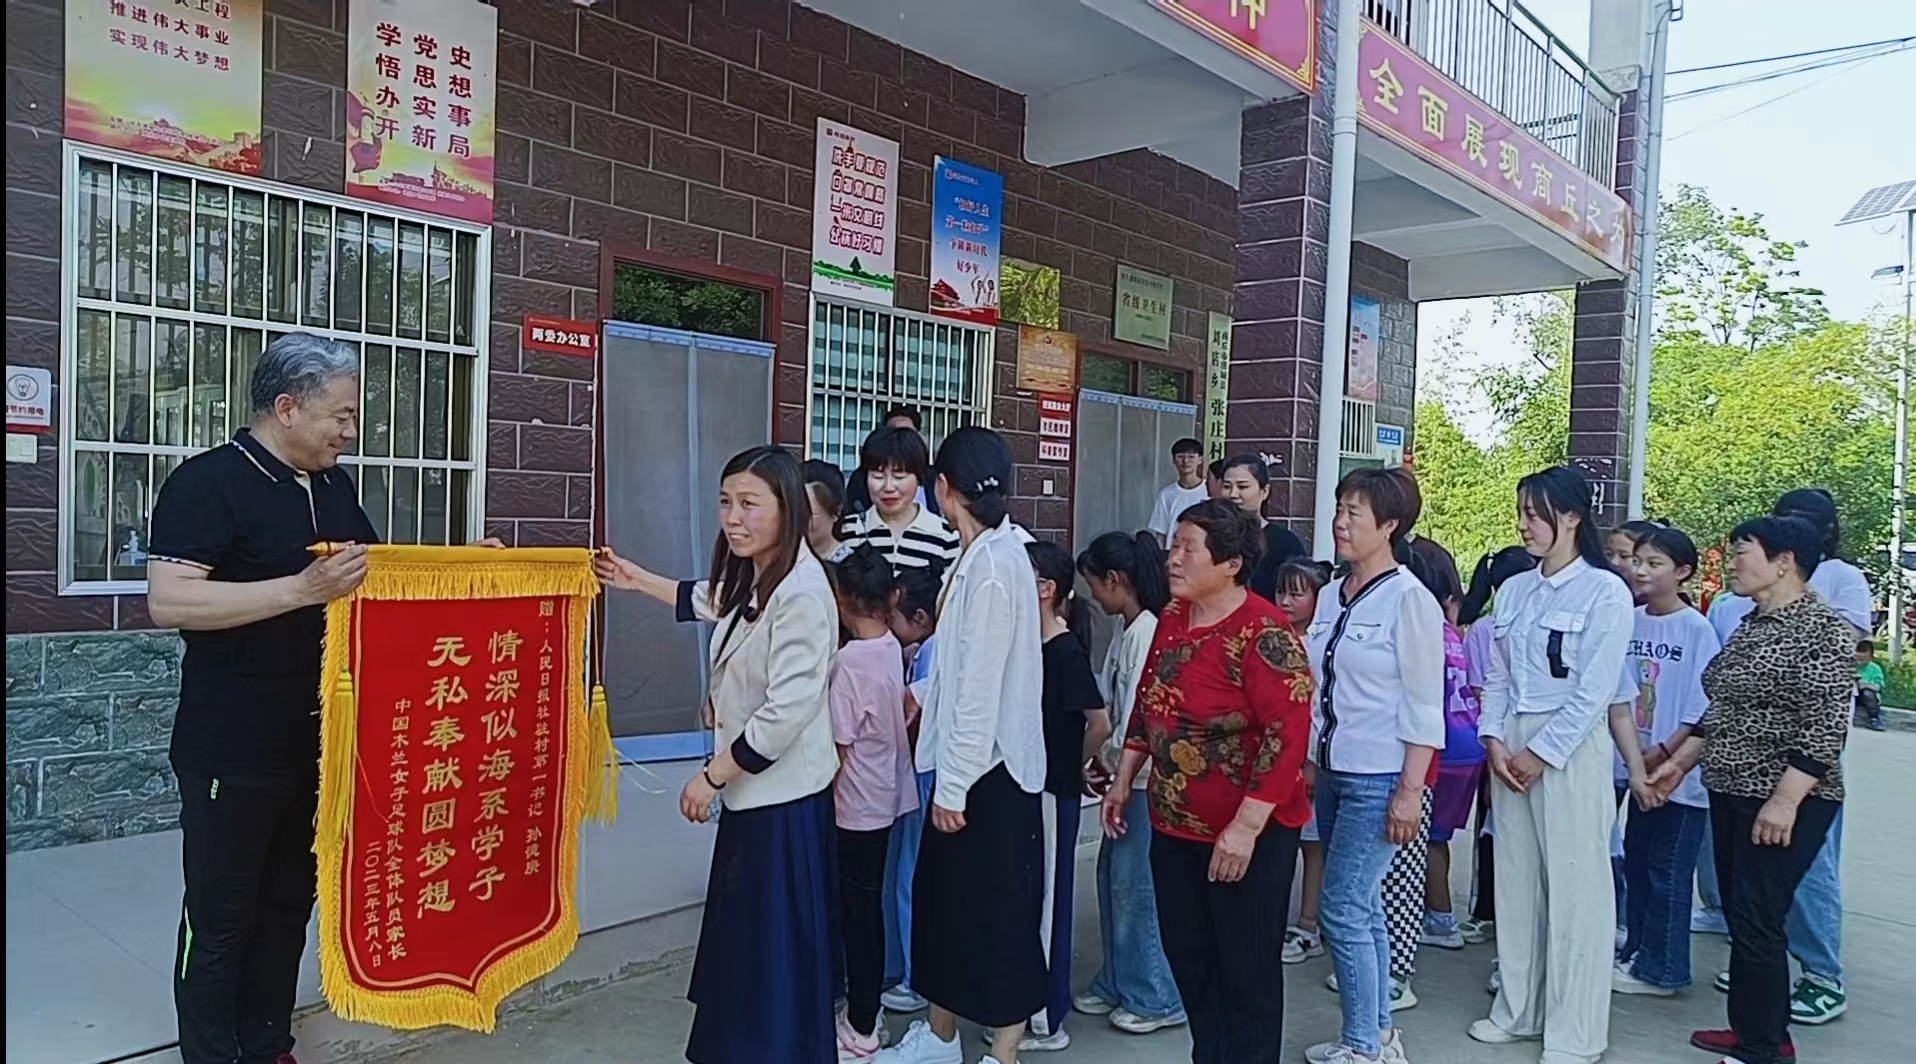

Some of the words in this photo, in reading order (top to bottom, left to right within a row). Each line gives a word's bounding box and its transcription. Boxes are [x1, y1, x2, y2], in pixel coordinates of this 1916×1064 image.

[110, 1, 229, 45] 推进伟大事业
[109, 28, 229, 71] 实现伟大梦想
[376, 22, 472, 71] 学党史
[375, 52, 472, 99] 悟思想
[376, 85, 472, 128] 办实事
[375, 115, 470, 158] 开新局
[1121, 292, 1167, 316] 省级卫生村
[532, 327, 591, 348] 两委办公室
[417, 637, 472, 919] 无私奉献圆梦想
[469, 629, 523, 900] 情深似海系学子
[384, 698, 411, 960] 中国木兰女子足球队全体队员家长
